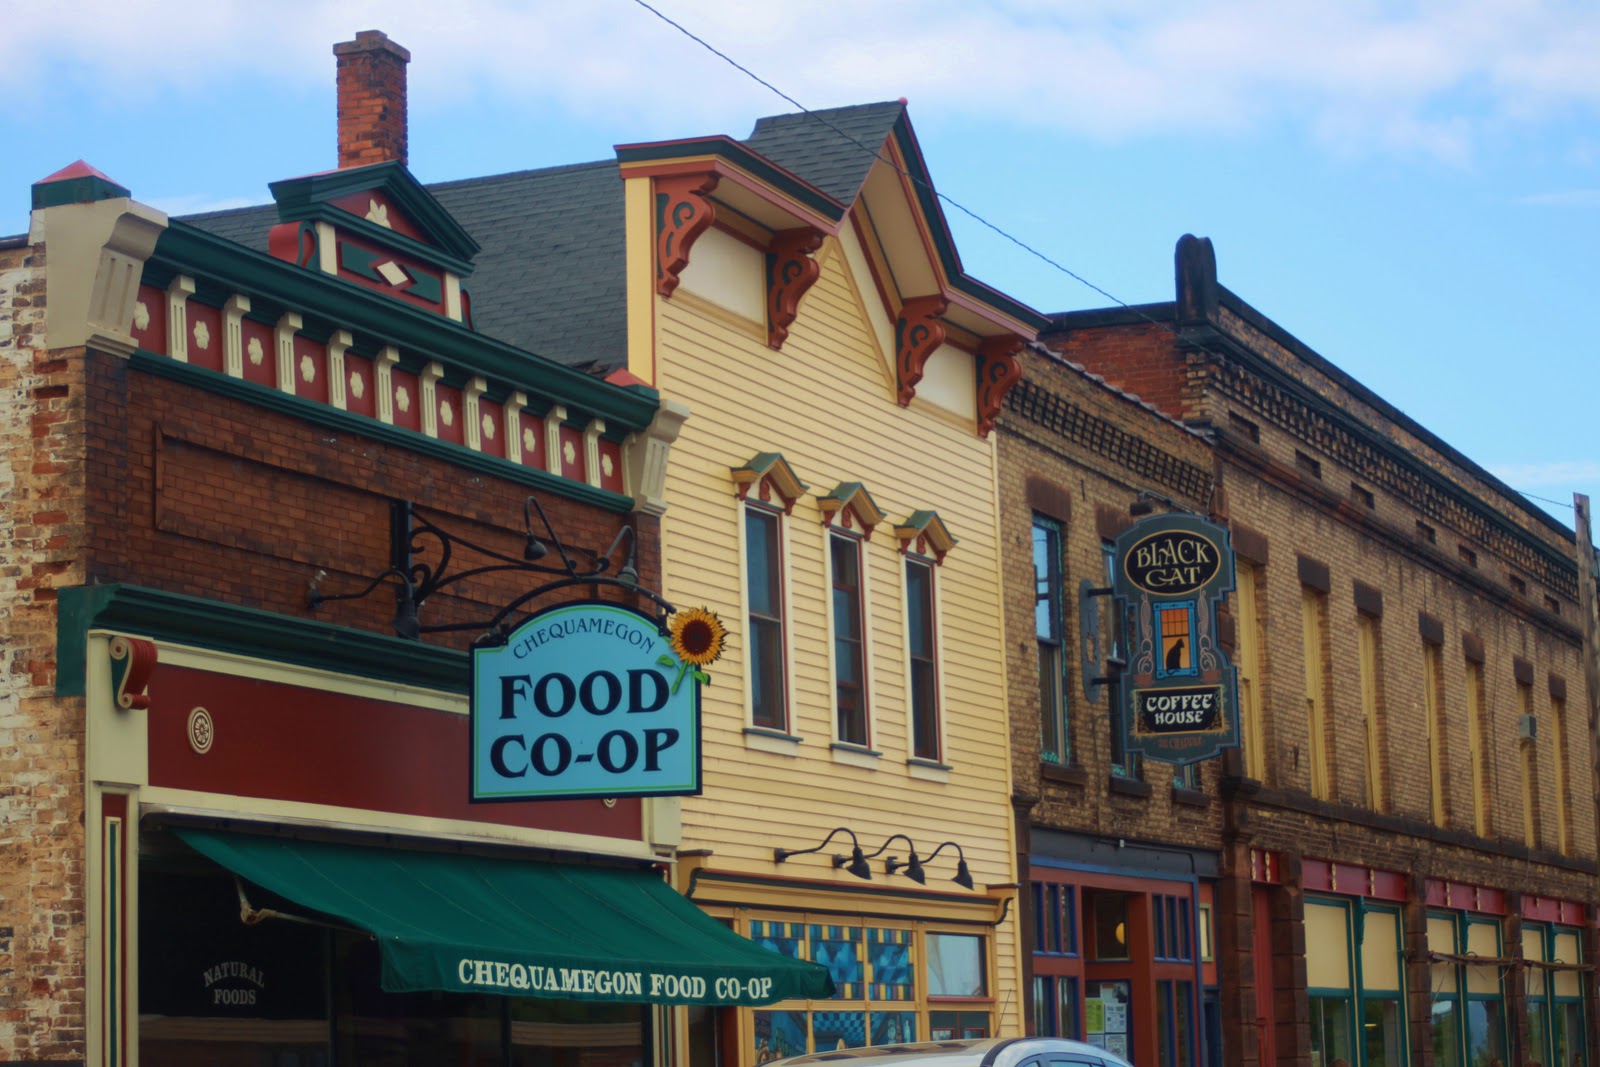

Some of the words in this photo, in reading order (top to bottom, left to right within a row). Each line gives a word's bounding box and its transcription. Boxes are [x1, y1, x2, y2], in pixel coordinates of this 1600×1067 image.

[1136, 539, 1211, 568] BLACK
[1145, 566, 1200, 587] CAT
[513, 618, 655, 659] CHEQUAMEGON
[499, 669, 670, 720] FOOD
[1146, 694, 1213, 712] COFFEE
[1154, 711, 1204, 725] HOUSE
[490, 728, 680, 778] CO-OP
[203, 961, 264, 988] NATURAL
[458, 959, 642, 995] CHEQUAMEGON
[650, 973, 706, 998] FOOD
[715, 977, 772, 999] CO-OP
[213, 989, 256, 1005] FOODS
